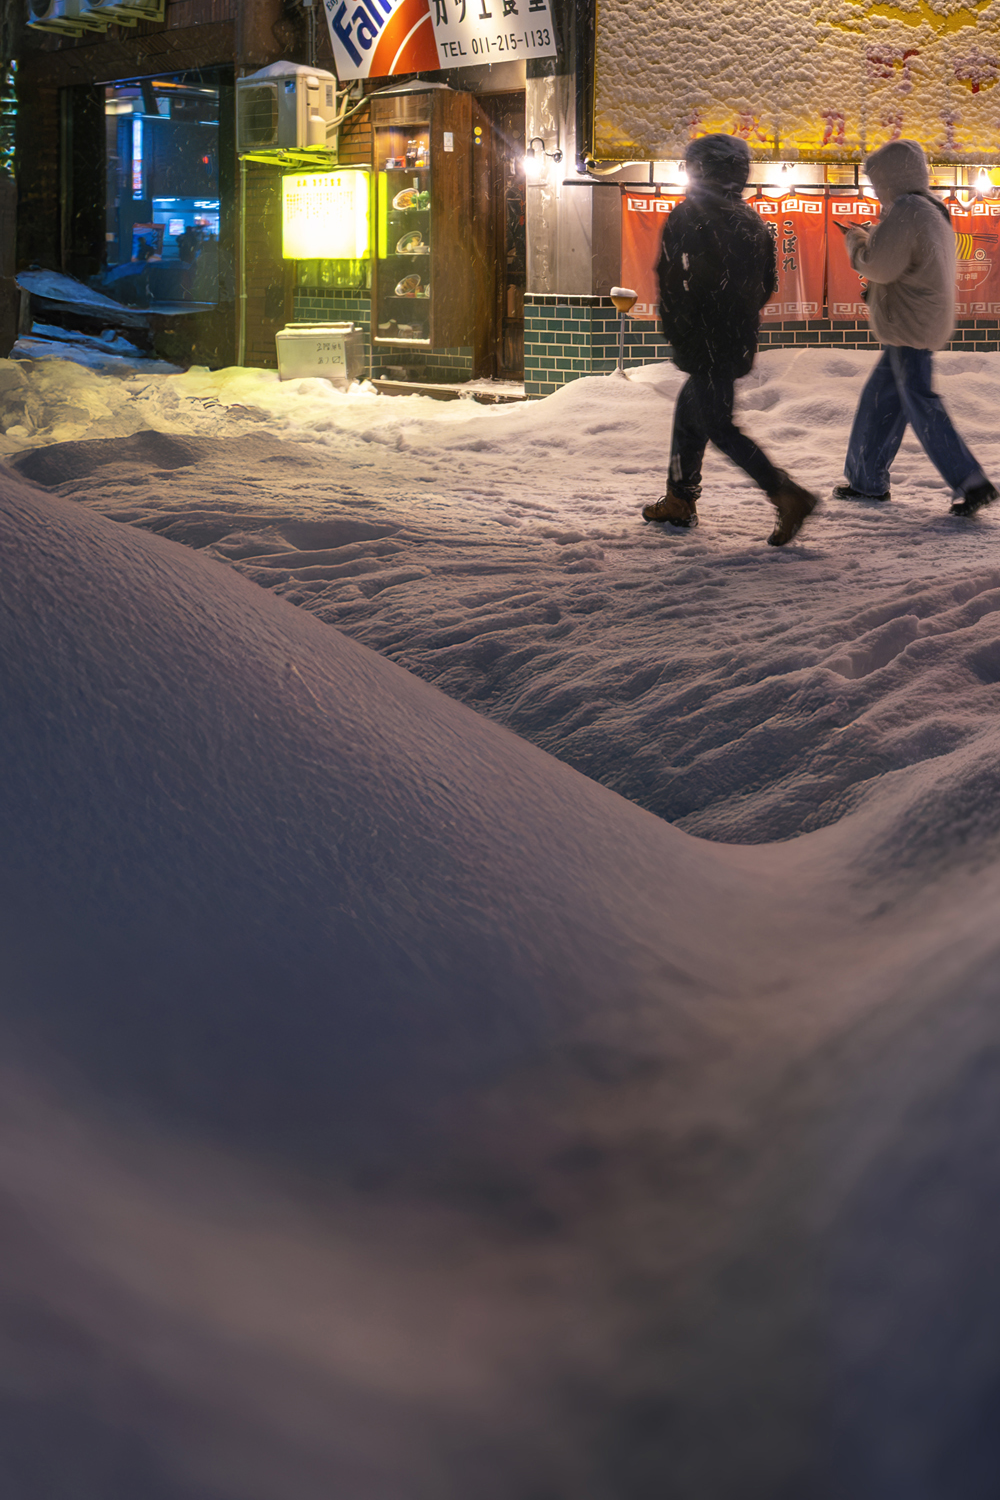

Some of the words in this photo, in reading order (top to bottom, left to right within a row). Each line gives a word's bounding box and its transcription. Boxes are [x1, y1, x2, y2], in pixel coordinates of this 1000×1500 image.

[440, 41, 467, 58] TEL
[471, 28, 552, 55] 011-215-1133
[783, 220, 798, 273] こぼれ
